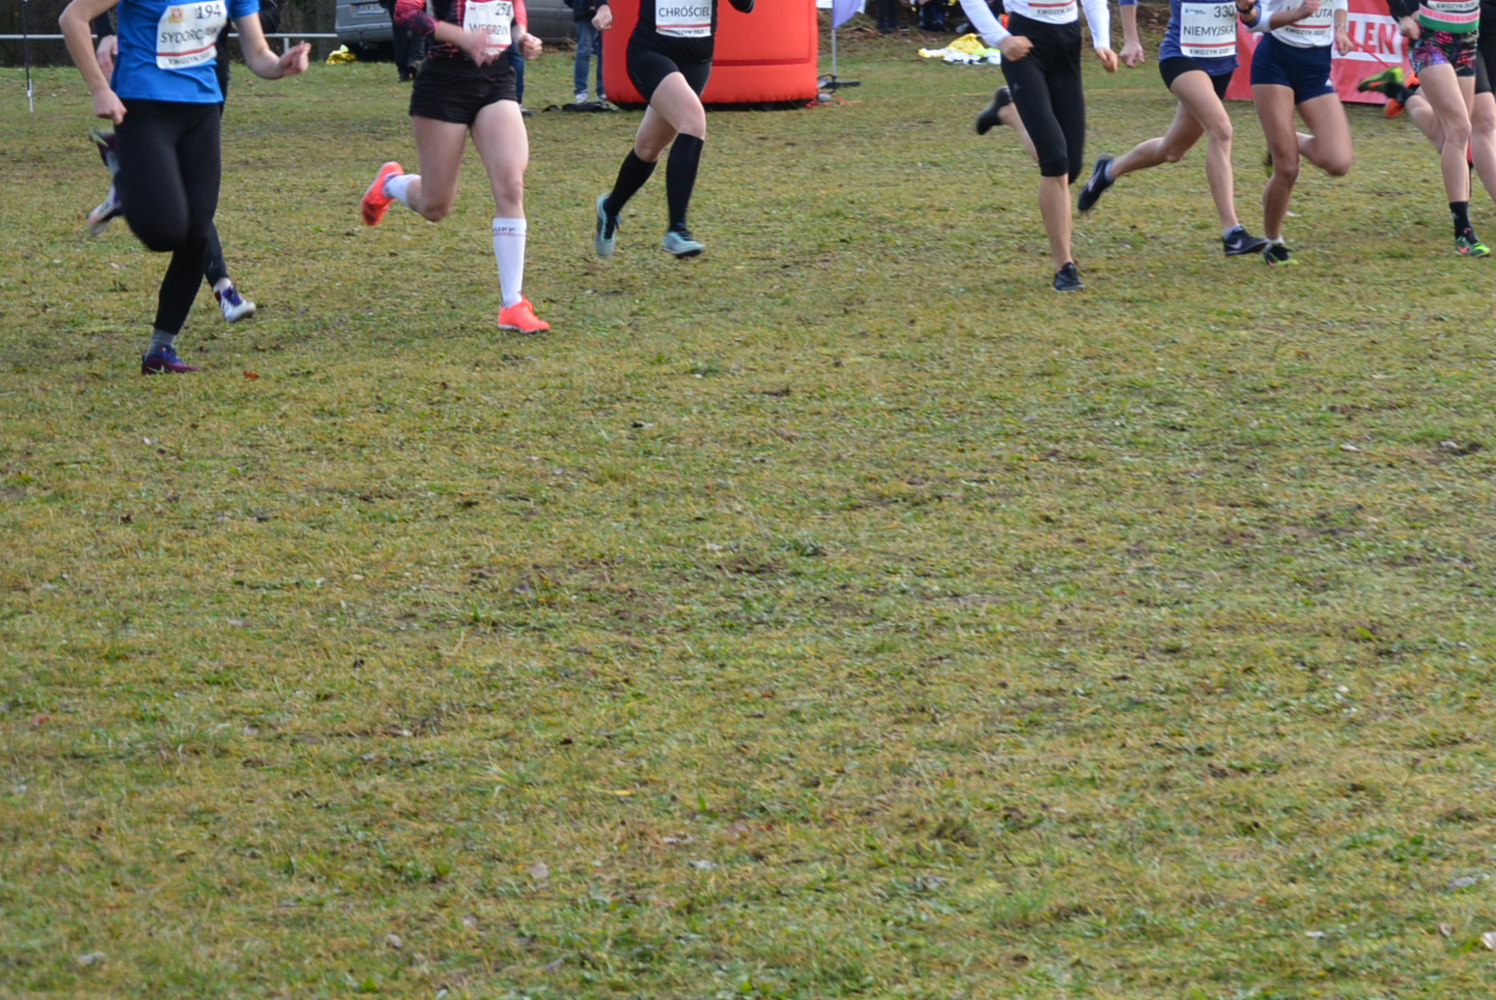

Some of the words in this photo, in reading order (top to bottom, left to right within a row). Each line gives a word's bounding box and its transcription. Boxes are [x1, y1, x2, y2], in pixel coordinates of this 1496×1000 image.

[196, 4, 221, 19] 194
[659, 5, 710, 17] CHRÓŚCIEL
[1214, 5, 1235, 18] 330
[1183, 25, 1234, 36] NIEMYJSKA
[1348, 20, 1397, 55] LEN
